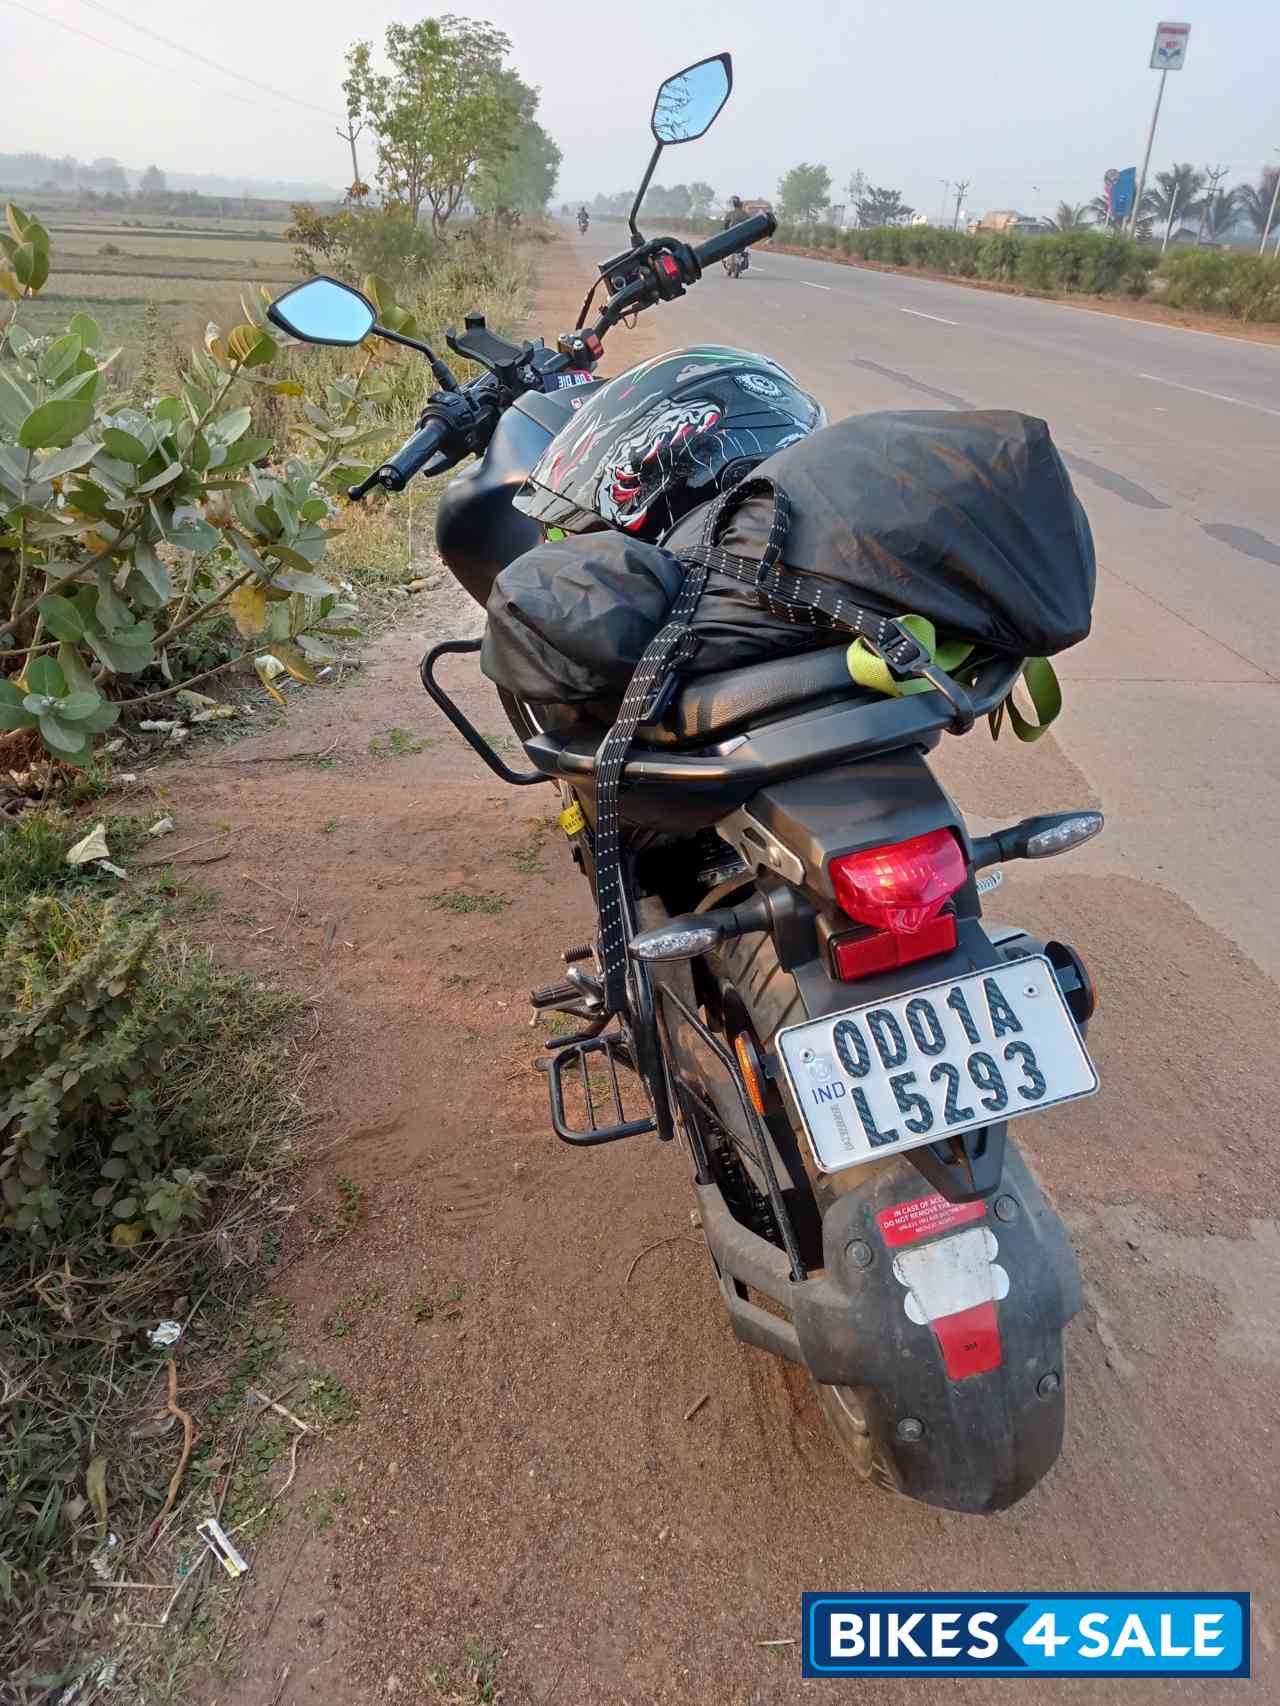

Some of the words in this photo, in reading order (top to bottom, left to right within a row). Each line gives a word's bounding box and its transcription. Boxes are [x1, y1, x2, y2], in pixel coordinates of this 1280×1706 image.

[811, 1081, 846, 1105] IND
[852, 1040, 1047, 1148] L5293
[883, 1220, 895, 1229] DO
[895, 1214, 909, 1224] NOT
[910, 1206, 938, 1218] REMOVE
[902, 1204, 920, 1215] CASE
